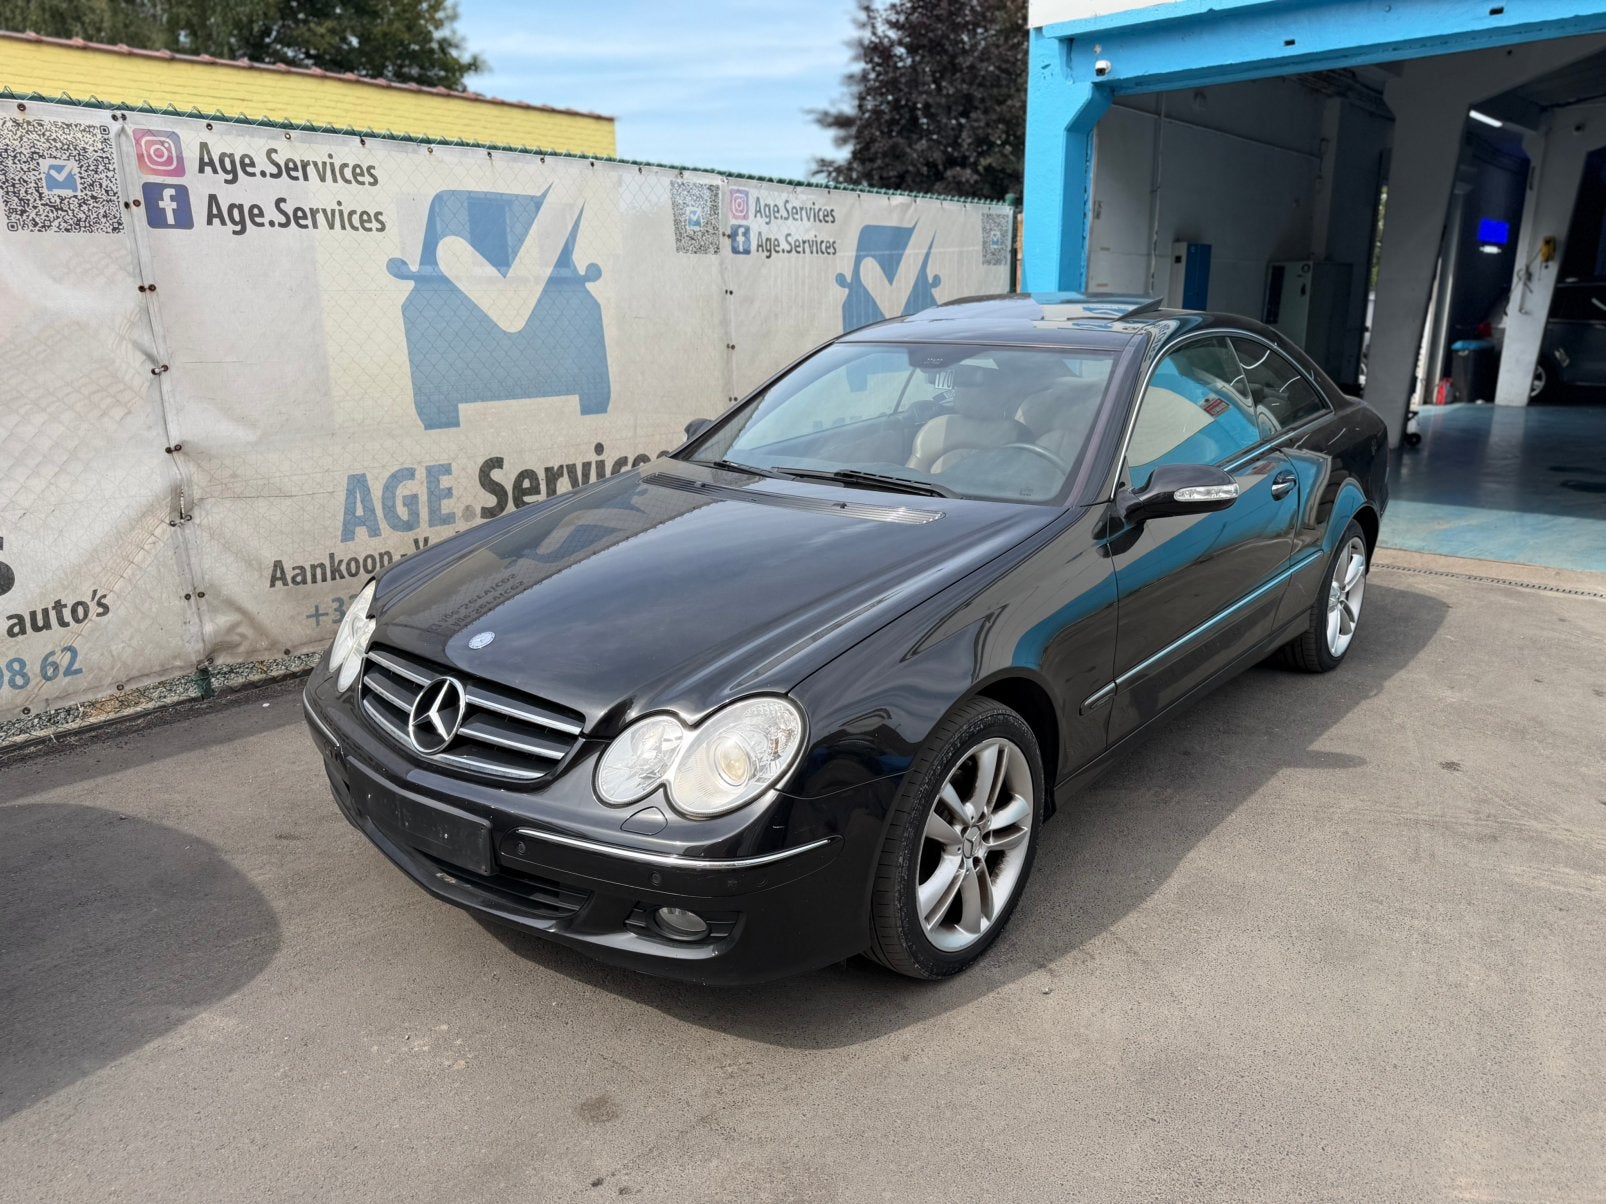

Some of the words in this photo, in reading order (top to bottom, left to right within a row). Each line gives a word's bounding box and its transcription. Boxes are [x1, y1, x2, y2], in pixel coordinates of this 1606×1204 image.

[198, 141, 379, 187] Age.Services
[206, 193, 387, 235] Age.Services
[754, 196, 836, 225] Age.Services
[756, 231, 837, 259] Age.Services
[340, 442, 670, 543] AGE.Servi
[6, 589, 110, 638] auto's
[305, 594, 360, 627] +3
[0, 657, 31, 690] 8
[40, 645, 83, 682] 62
